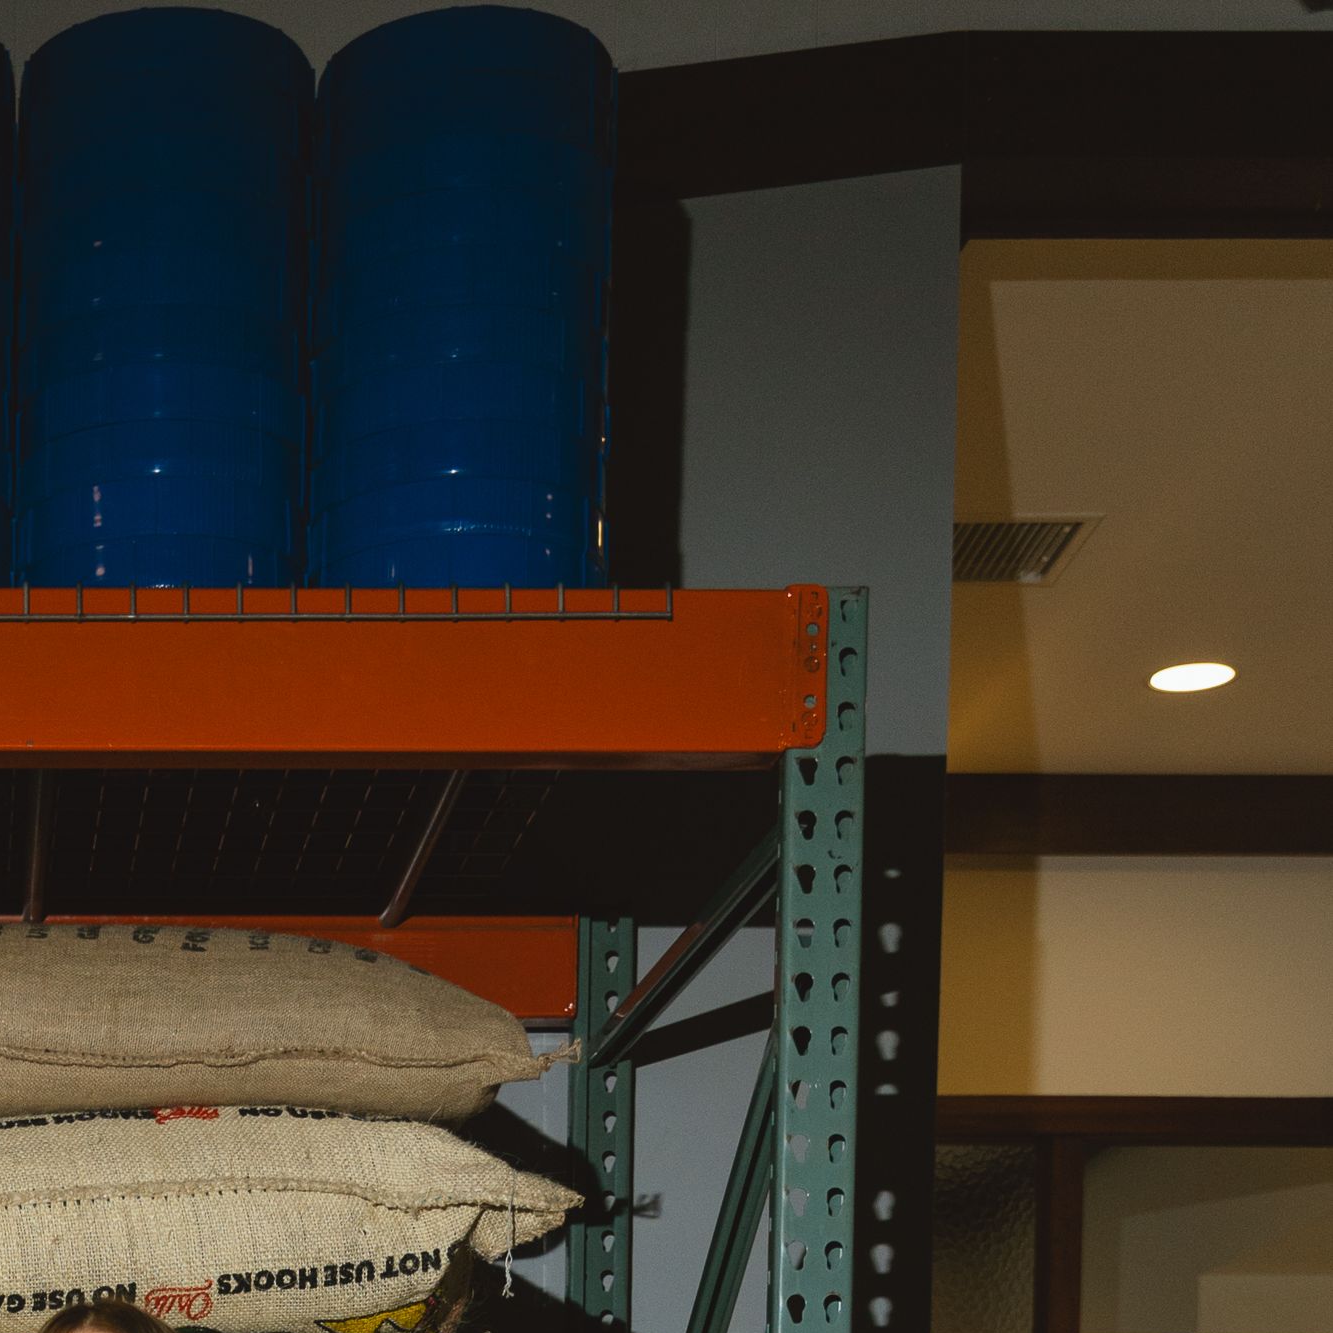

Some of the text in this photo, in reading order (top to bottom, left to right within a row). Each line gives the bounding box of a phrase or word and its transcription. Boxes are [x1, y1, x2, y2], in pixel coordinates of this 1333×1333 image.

[323, 1261, 374, 1287] USE
[380, 1248, 441, 1279] NOT
[216, 1265, 318, 1296] HOOKS
[33, 1288, 85, 1312] USE
[93, 1282, 137, 1308] NO
